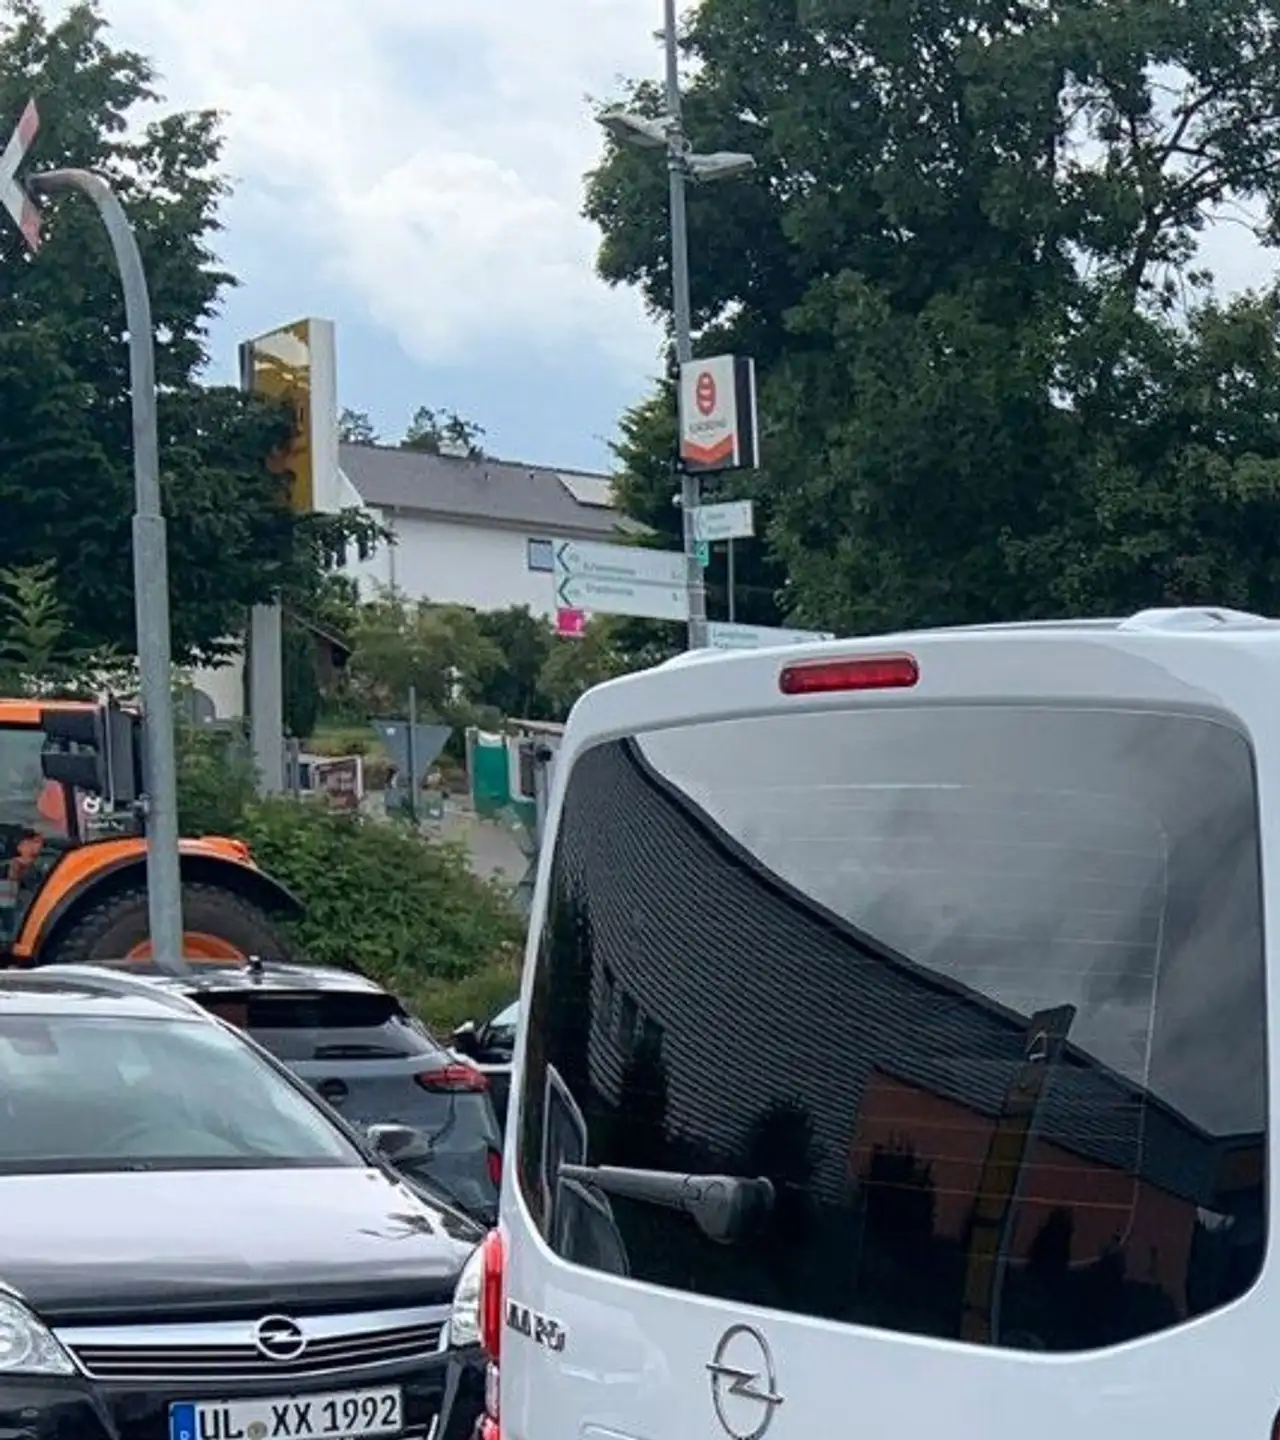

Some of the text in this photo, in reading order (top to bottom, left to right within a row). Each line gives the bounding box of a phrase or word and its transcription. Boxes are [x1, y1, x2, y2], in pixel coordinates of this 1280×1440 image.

[199, 1408, 244, 1440] UL
[271, 1402, 313, 1437] XX
[322, 1394, 398, 1433] 1992
